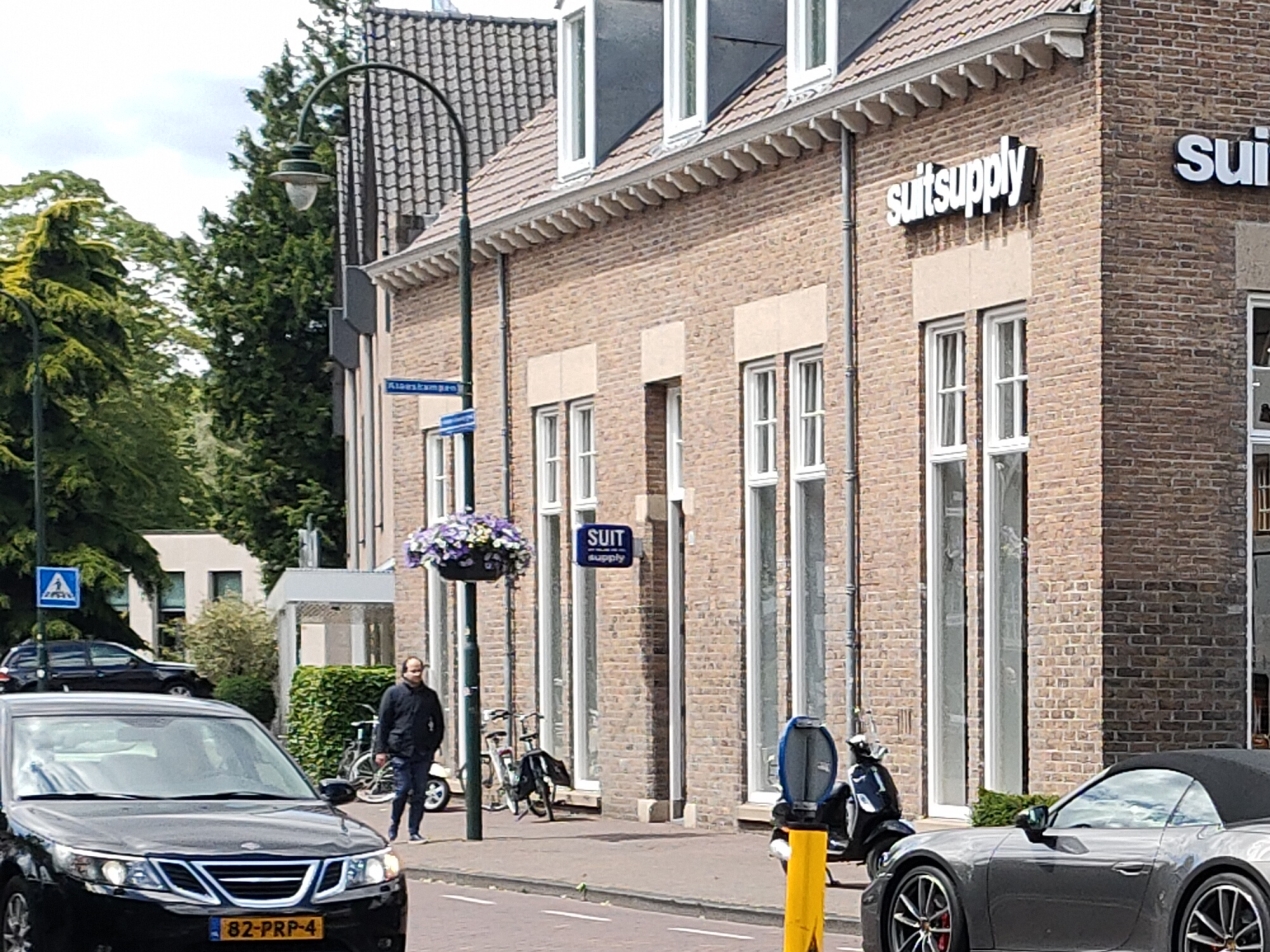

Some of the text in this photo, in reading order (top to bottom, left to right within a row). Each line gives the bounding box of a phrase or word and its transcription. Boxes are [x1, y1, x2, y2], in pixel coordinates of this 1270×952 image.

[887, 135, 1026, 226] suitsupply
[587, 529, 625, 546] SUIT
[587, 553, 626, 563] supply
[228, 920, 316, 937] 82-PRP-4
